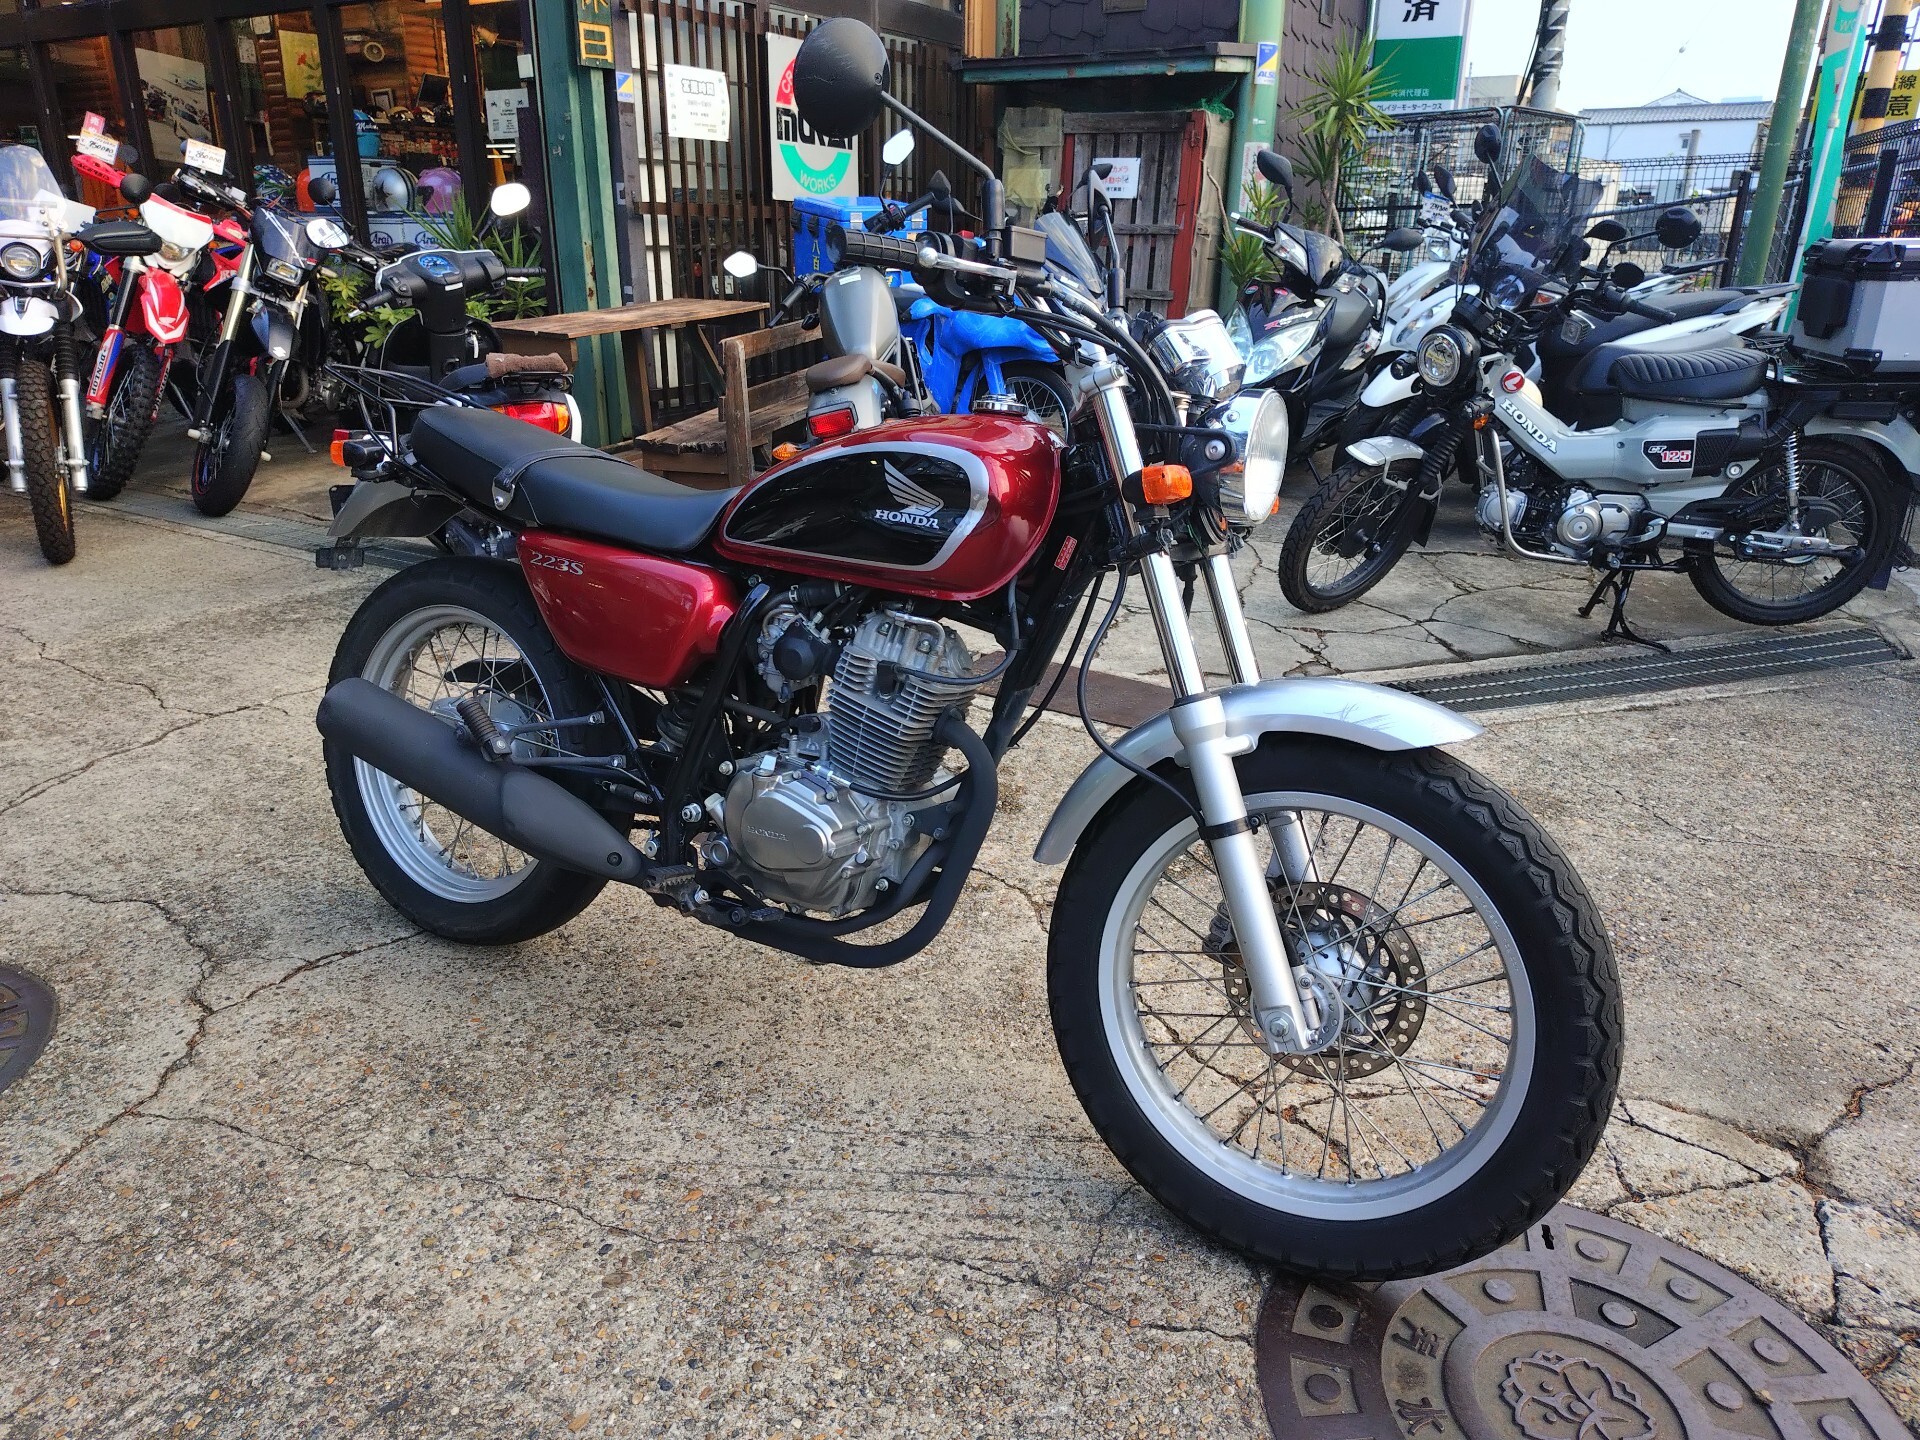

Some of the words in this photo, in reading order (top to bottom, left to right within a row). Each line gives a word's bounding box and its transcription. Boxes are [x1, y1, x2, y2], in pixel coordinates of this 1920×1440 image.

[800, 169, 836, 193] WORKS
[91, 352, 107, 396] DUNLOP
[1499, 398, 1558, 453] HONDA
[1661, 450, 1692, 463] 125
[874, 509, 940, 530] HONDA
[530, 551, 584, 575] 223S
